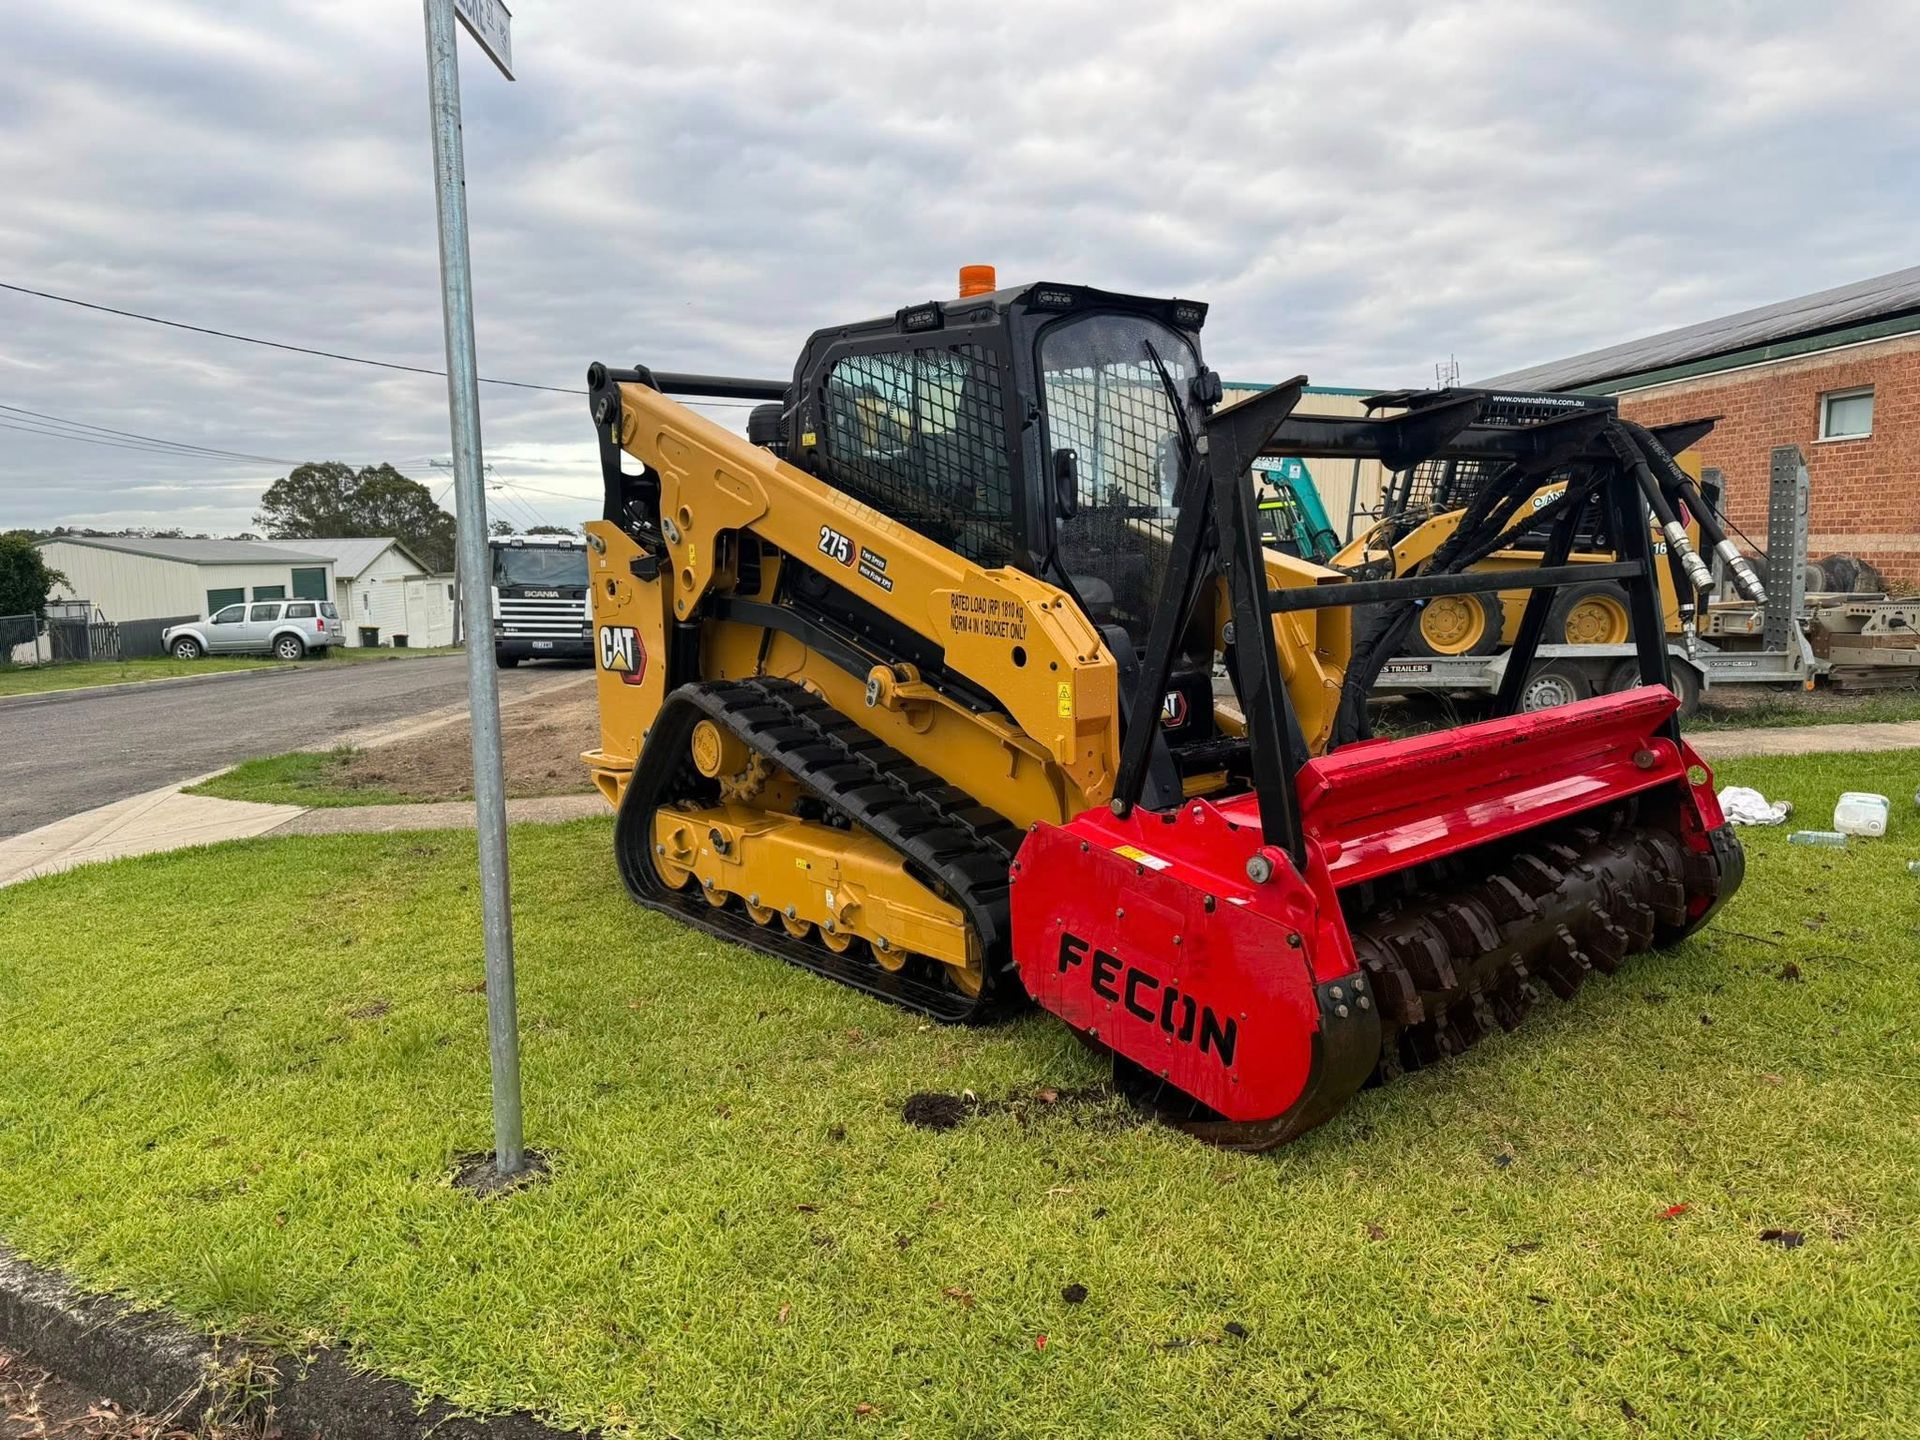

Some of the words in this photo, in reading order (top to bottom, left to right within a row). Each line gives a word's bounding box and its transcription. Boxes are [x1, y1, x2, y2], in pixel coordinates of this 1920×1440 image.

[1492, 395, 1585, 407] www.ovannahhire.com.au
[819, 526, 849, 563] 275
[524, 590, 560, 598] SCANIA
[951, 593, 969, 612] RATED
[971, 596, 987, 614] LOAD
[988, 598, 1000, 619] (RP)
[1001, 601, 1015, 618] 1810
[1016, 602, 1024, 624] kg
[951, 614, 968, 632] NORM
[973, 617, 980, 634] IN
[984, 619, 1010, 639] BUCKET
[1010, 622, 1028, 641] ONLY
[600, 626, 635, 671] CAT
[1390, 665, 1428, 673] TRAILERS
[1058, 931, 1238, 1069] FECON
